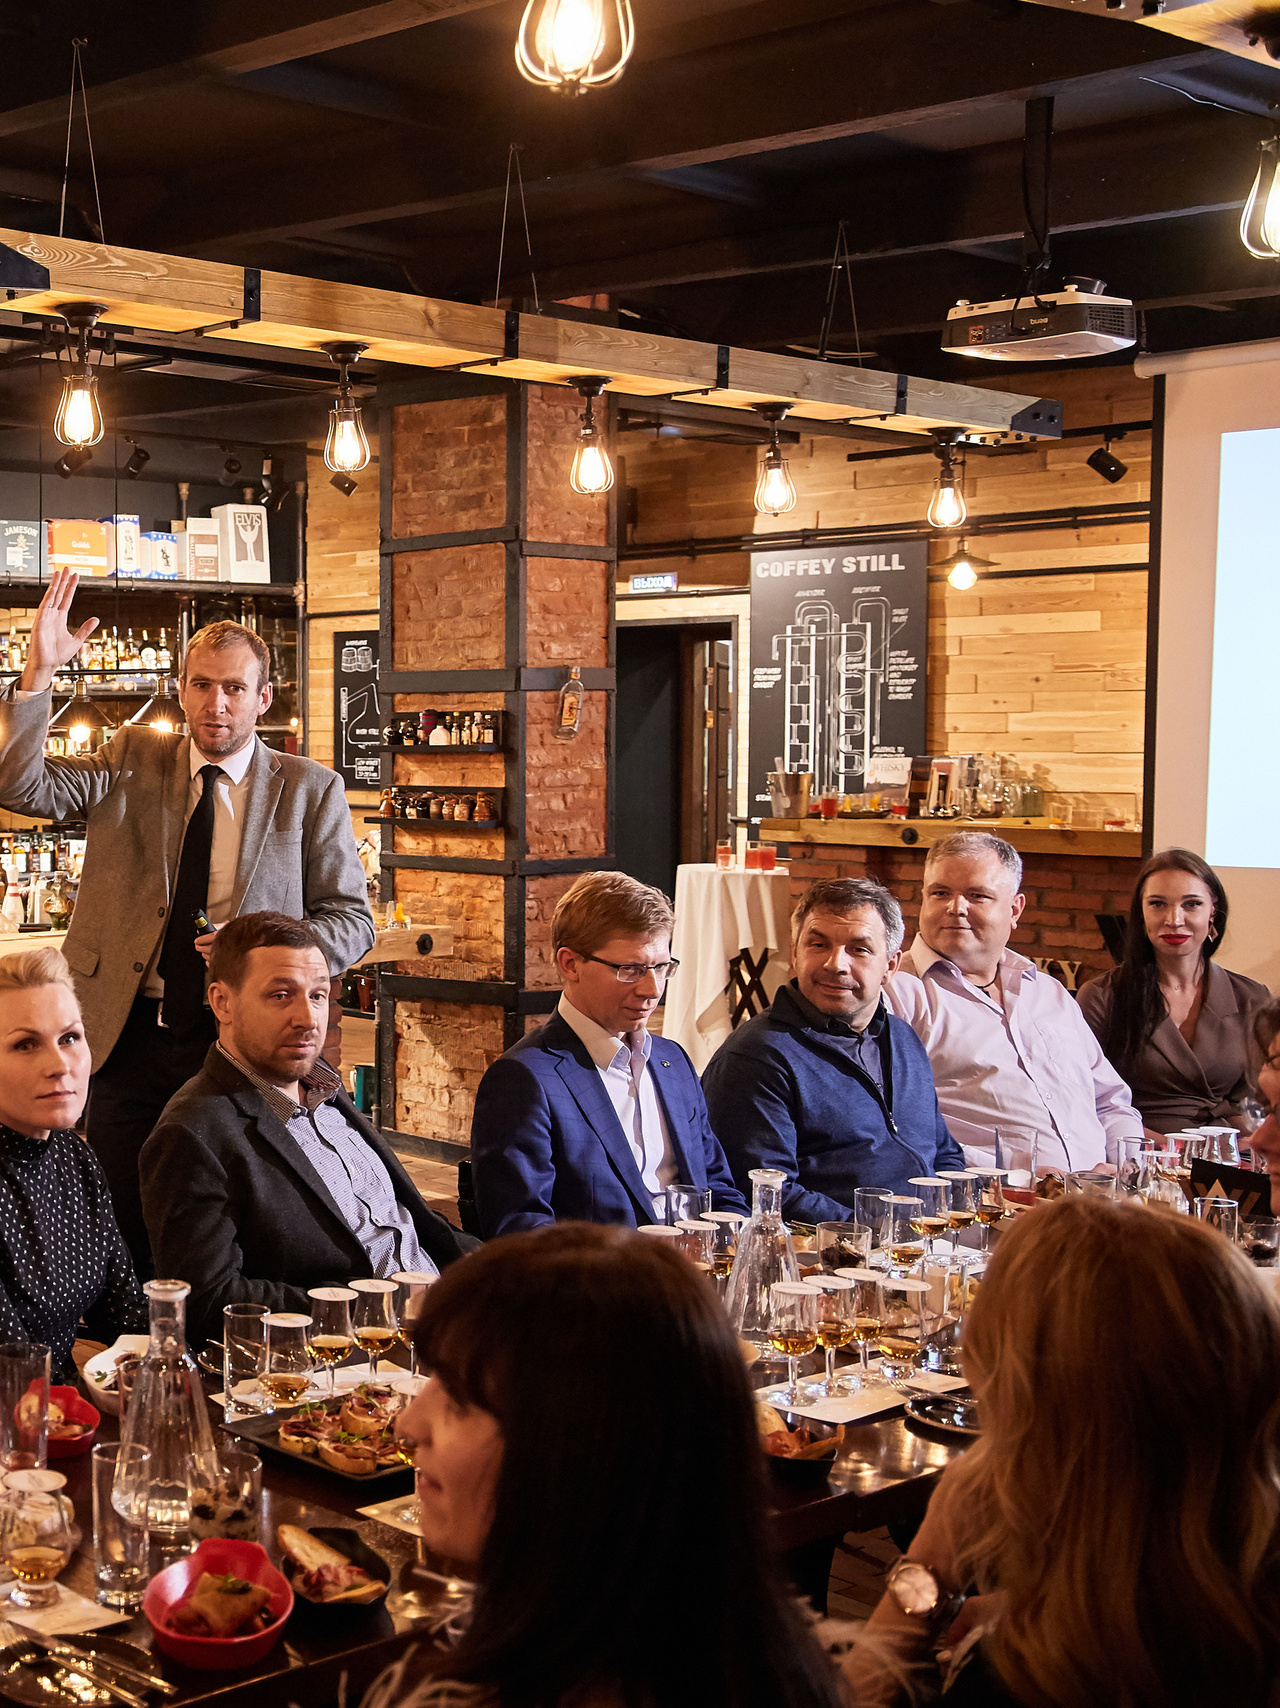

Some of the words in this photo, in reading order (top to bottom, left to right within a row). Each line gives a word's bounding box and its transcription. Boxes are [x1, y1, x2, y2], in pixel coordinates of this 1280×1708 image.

[235, 514, 261, 525] ELVIS
[4, 526, 38, 537] JAMESON
[756, 558, 836, 578] COFFEY
[842, 553, 905, 574] STILL
[633, 576, 672, 589] ВЫХОД
